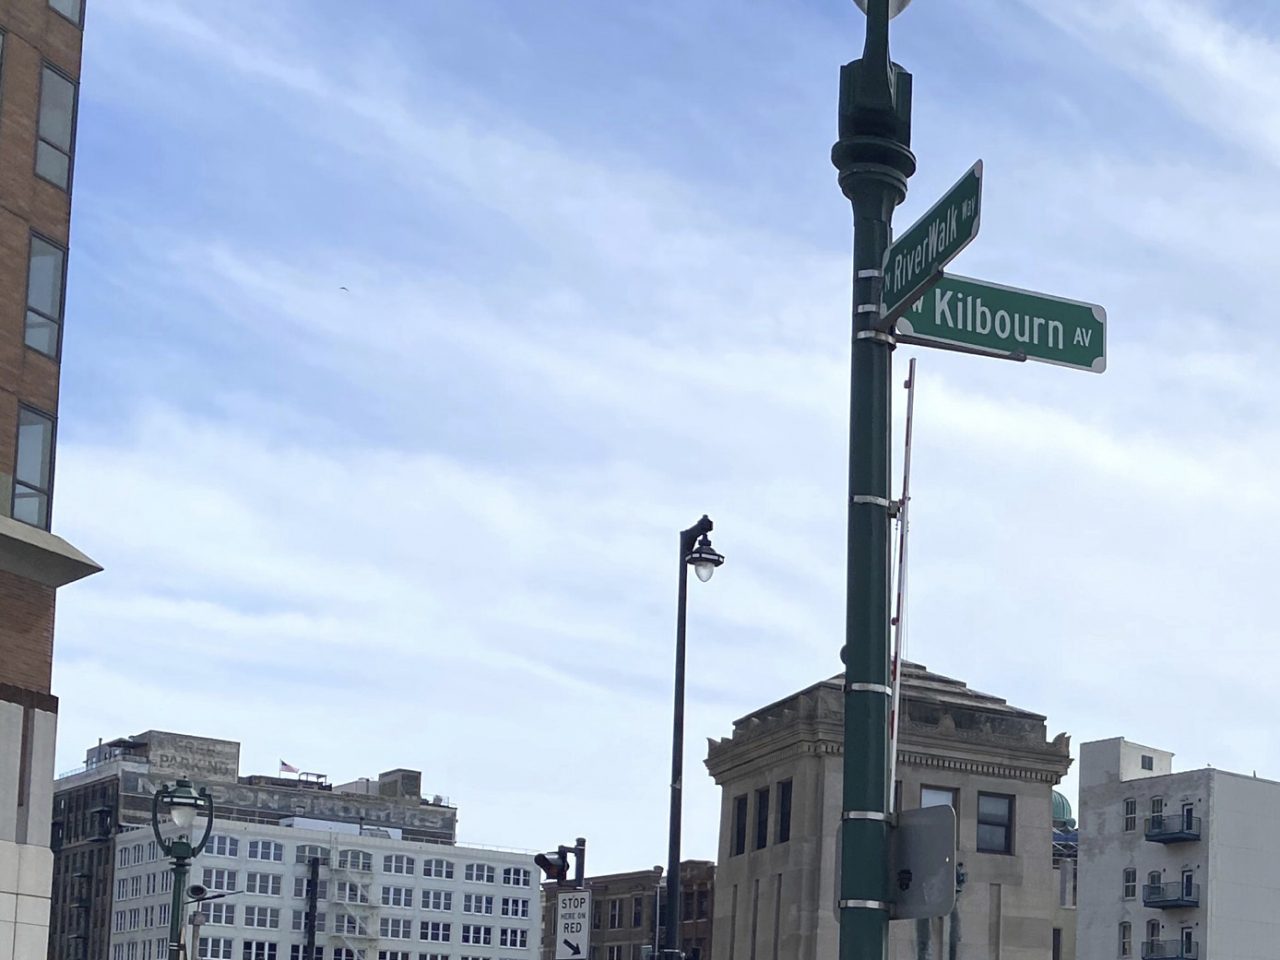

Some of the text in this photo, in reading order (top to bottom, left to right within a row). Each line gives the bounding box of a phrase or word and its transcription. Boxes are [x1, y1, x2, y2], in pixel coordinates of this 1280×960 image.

[894, 206, 958, 293] RiverWalk
[961, 198, 976, 222] Way
[935, 288, 1064, 350] Kilbourn
[1073, 327, 1092, 347] AV
[561, 897, 586, 909] STOP
[577, 912, 586, 920] ON
[563, 922, 582, 934] RED
